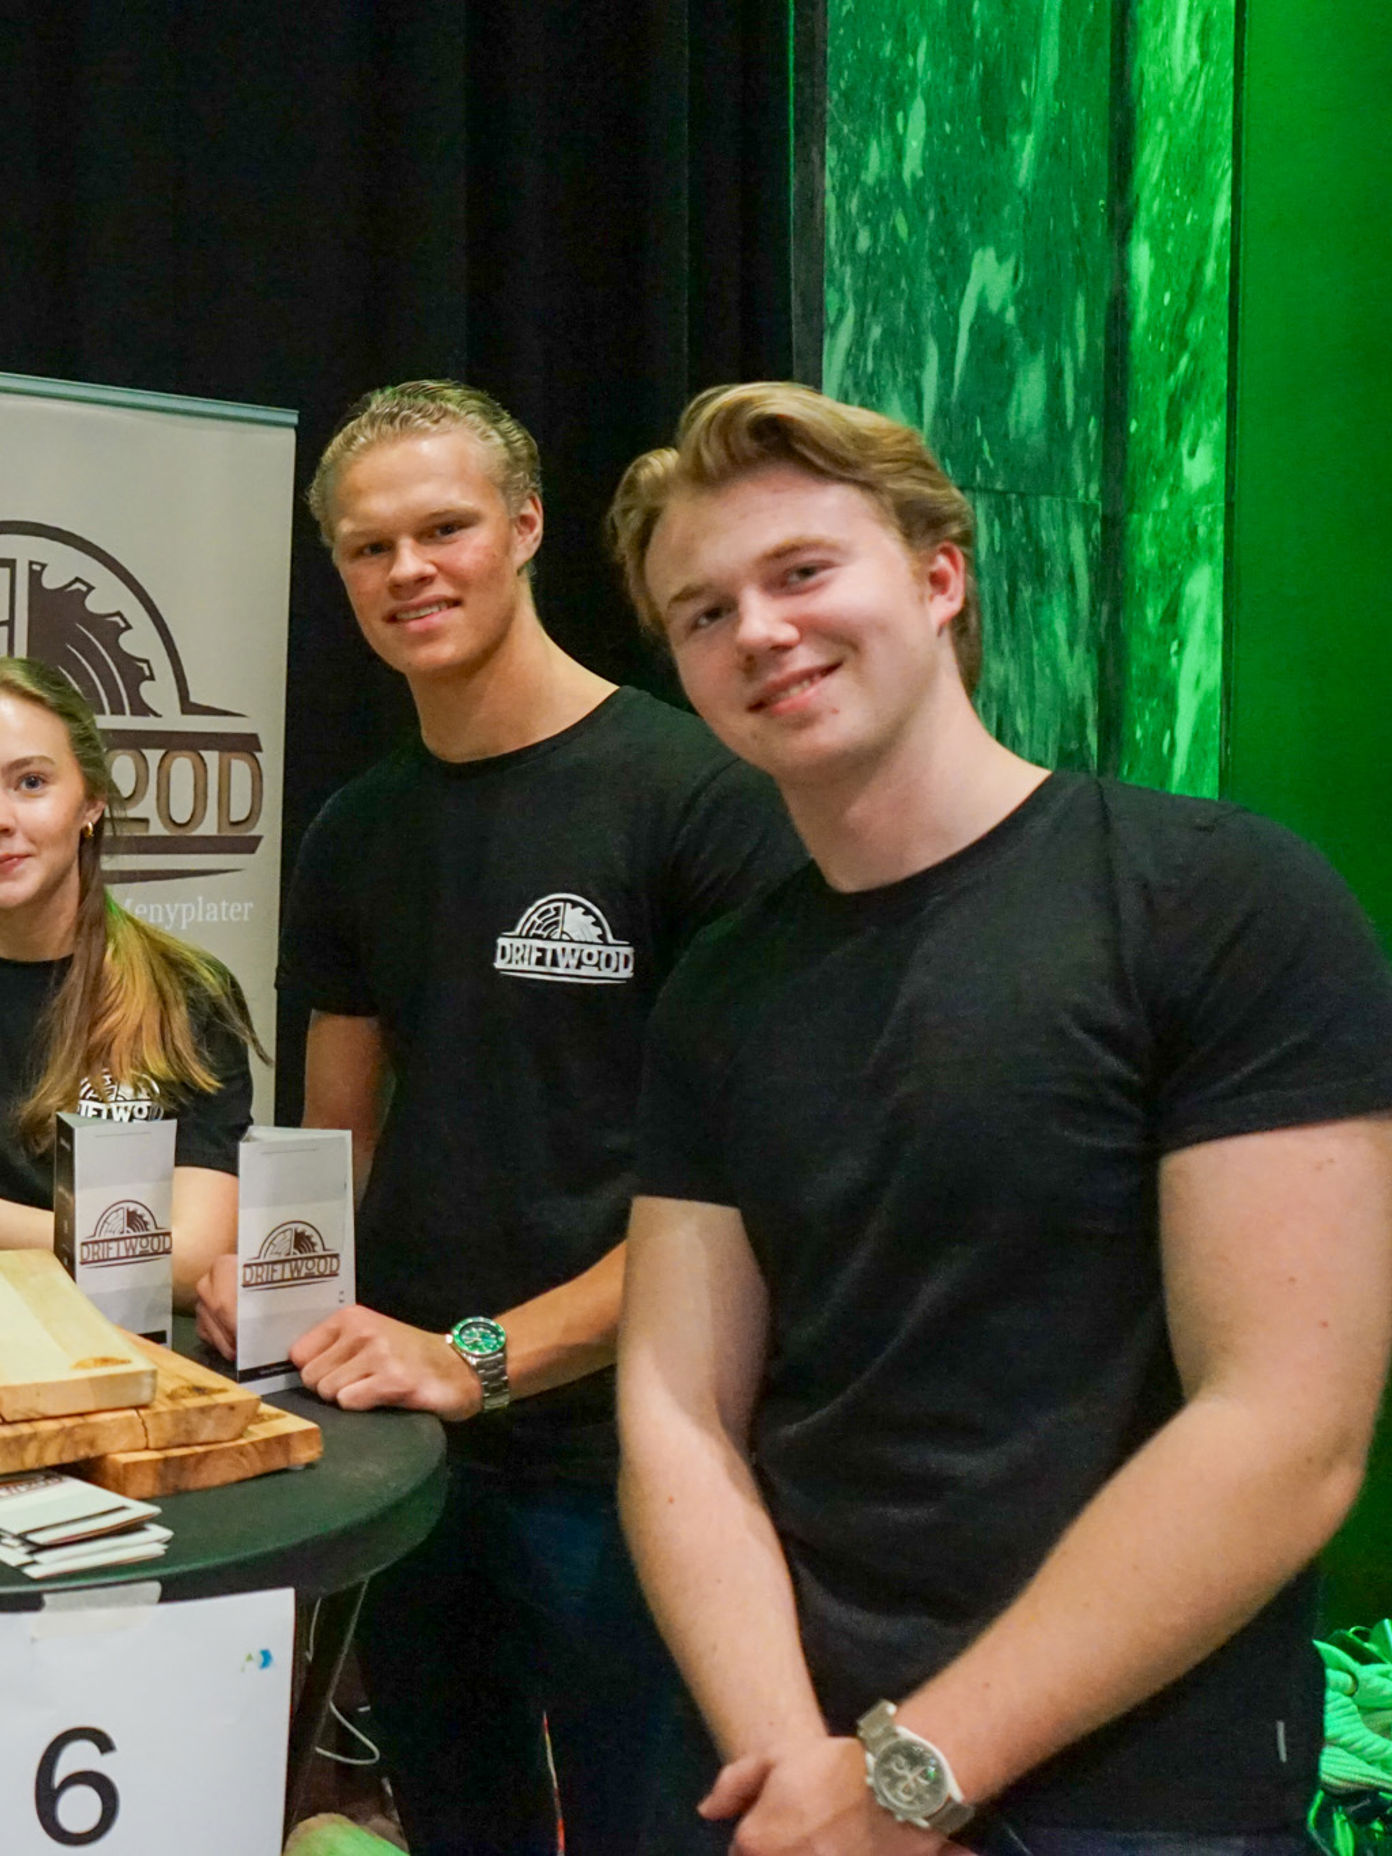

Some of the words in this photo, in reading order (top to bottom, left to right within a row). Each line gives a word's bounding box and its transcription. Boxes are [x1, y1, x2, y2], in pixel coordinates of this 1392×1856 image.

[123, 896, 254, 931] enyplater
[496, 940, 634, 977] DRIFTWOOD
[80, 1234, 173, 1262] DRIFTWOOD
[242, 1255, 340, 1286] DRIFTWOOD
[35, 1726, 120, 1847] 6
